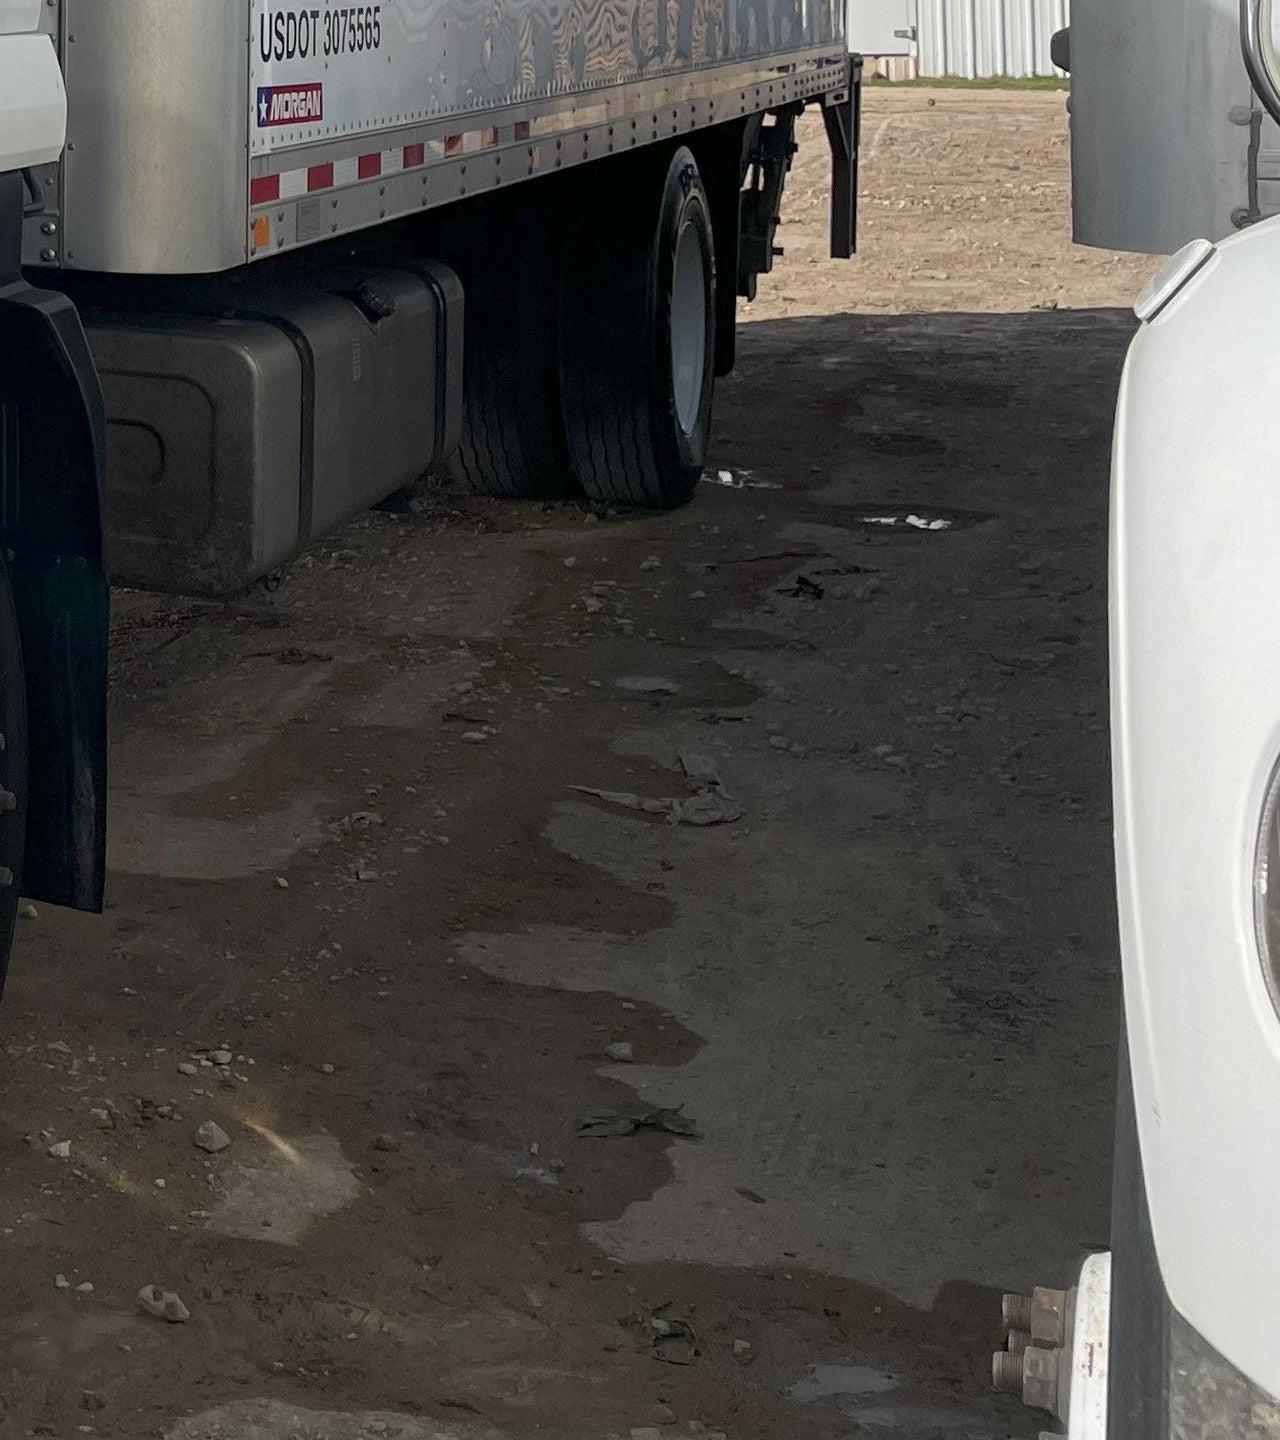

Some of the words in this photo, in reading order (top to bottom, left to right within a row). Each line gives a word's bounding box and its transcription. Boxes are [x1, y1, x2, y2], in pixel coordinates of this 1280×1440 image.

[260, 9, 321, 63] USDOT
[323, 5, 382, 57] 3075565
[270, 89, 322, 121] MORGAN
